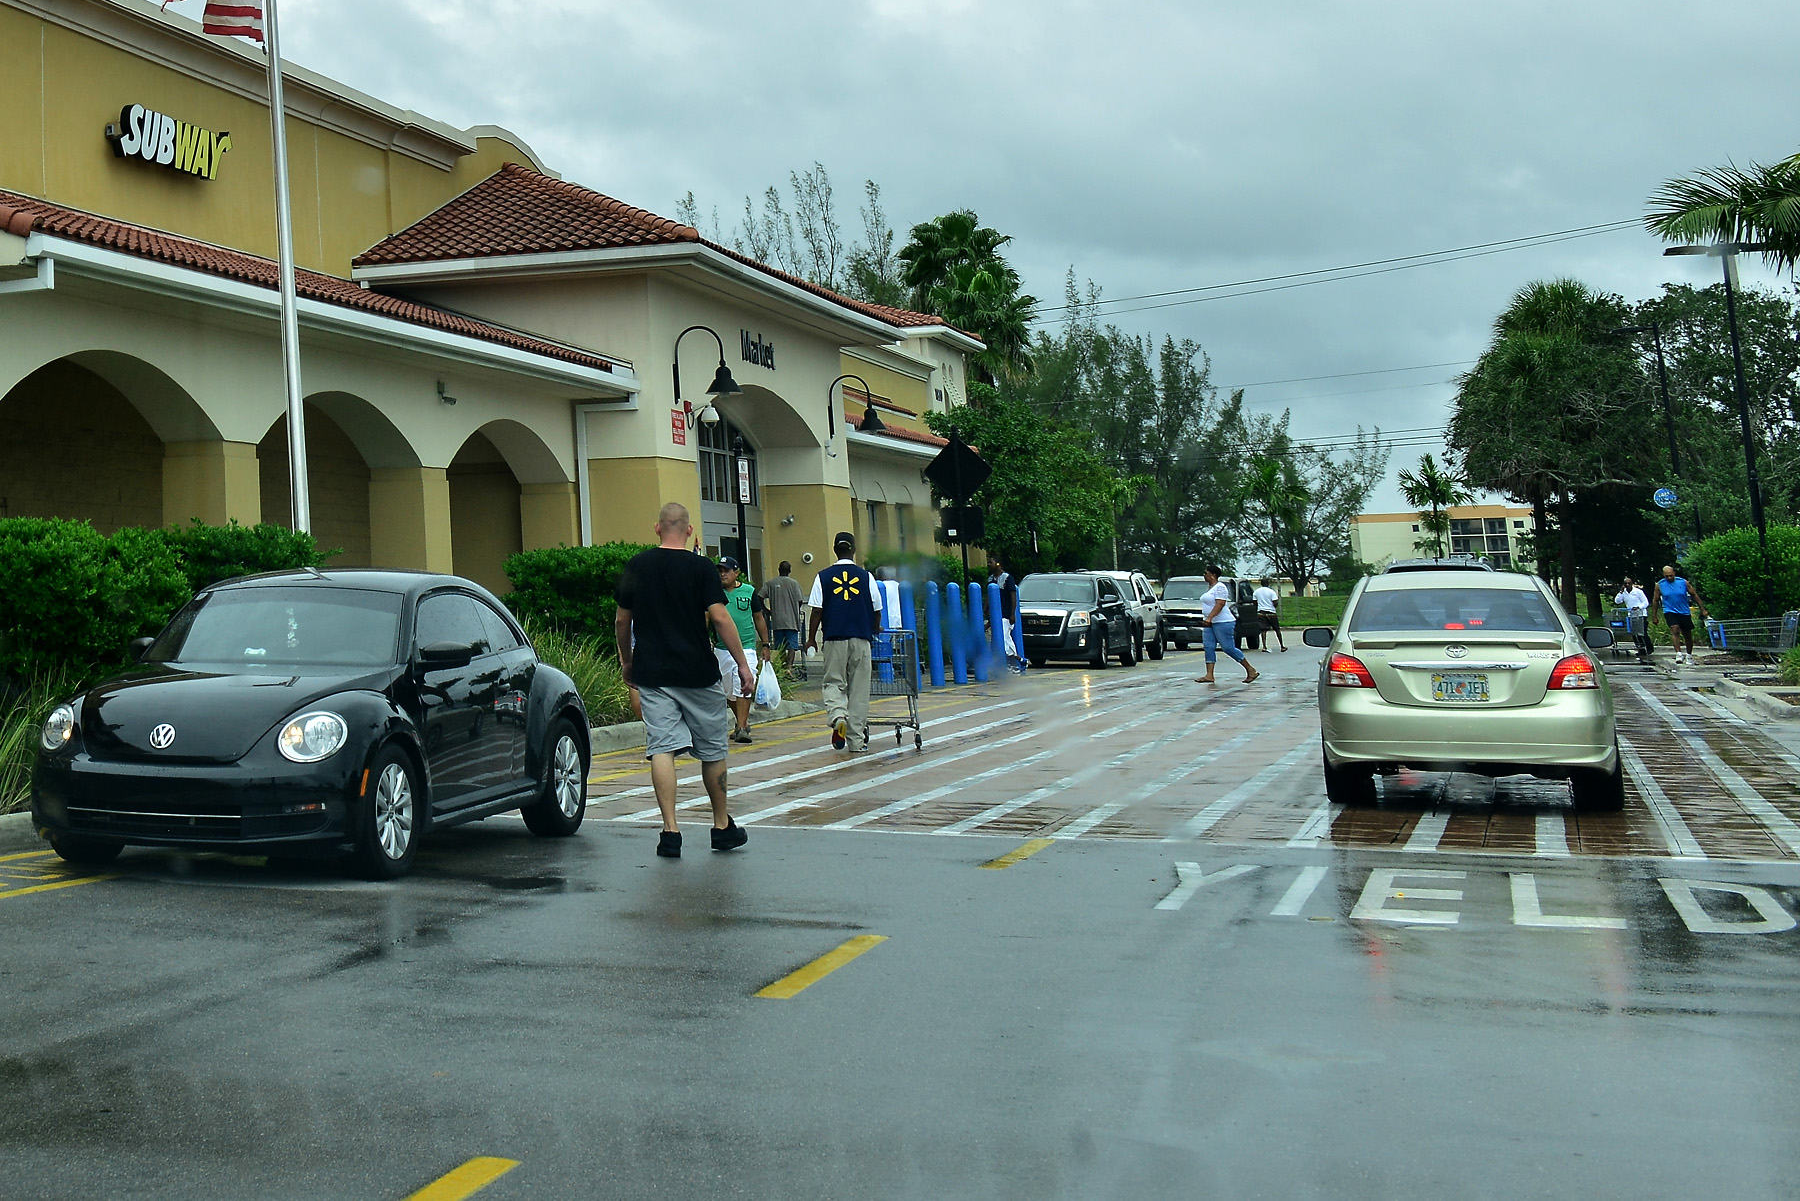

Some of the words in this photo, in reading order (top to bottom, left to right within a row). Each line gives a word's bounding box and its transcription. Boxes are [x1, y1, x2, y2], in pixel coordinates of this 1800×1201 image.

[120, 103, 233, 181] SUBWAY
[740, 328, 776, 371] Market
[1153, 861, 1798, 935] YIELD
